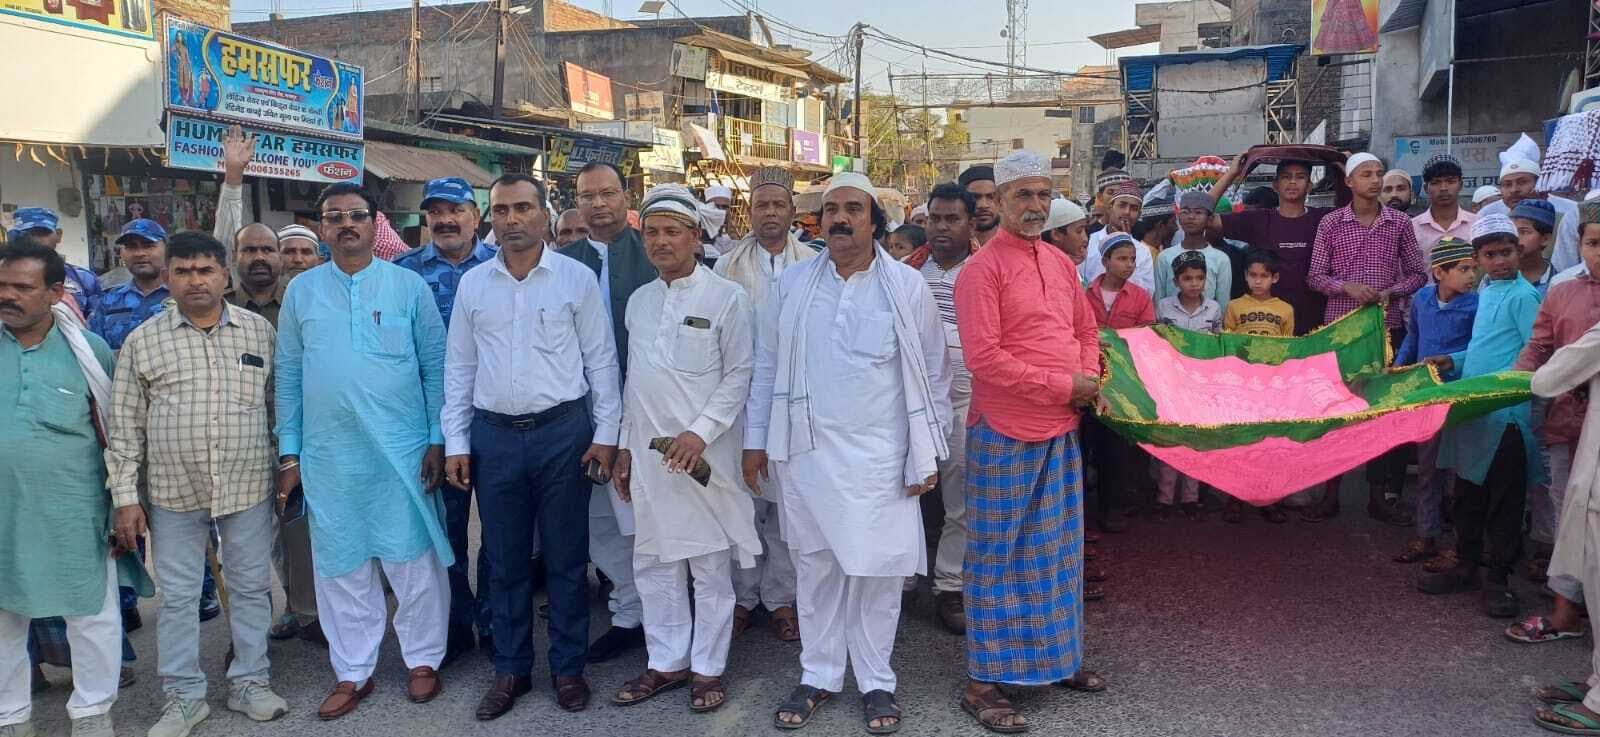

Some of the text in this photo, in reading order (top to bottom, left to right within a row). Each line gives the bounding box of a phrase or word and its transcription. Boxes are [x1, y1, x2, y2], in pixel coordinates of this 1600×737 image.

[217, 36, 313, 92] हमसफर
[176, 121, 284, 151] HUMFAR
[291, 140, 360, 160] हमसफर
